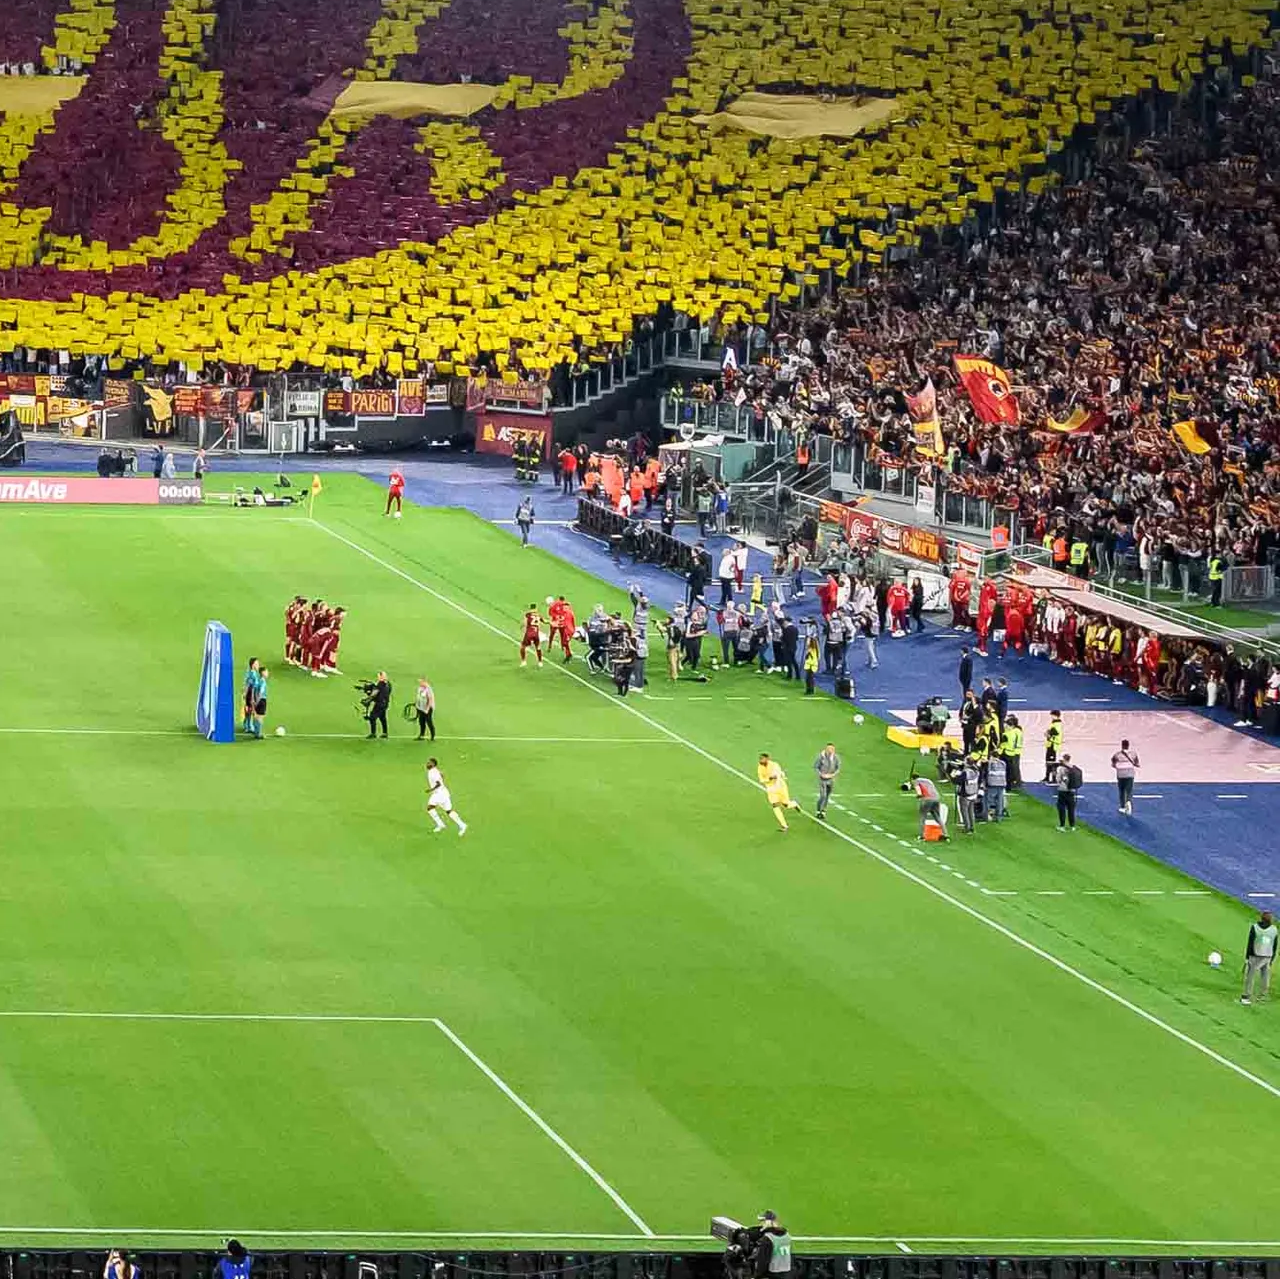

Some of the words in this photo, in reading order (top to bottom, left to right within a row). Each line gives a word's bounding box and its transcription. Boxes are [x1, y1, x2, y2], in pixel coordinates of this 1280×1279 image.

[722, 347, 738, 369] A
[400, 381, 423, 397] AVE
[159, 485, 201, 499] 00:00
